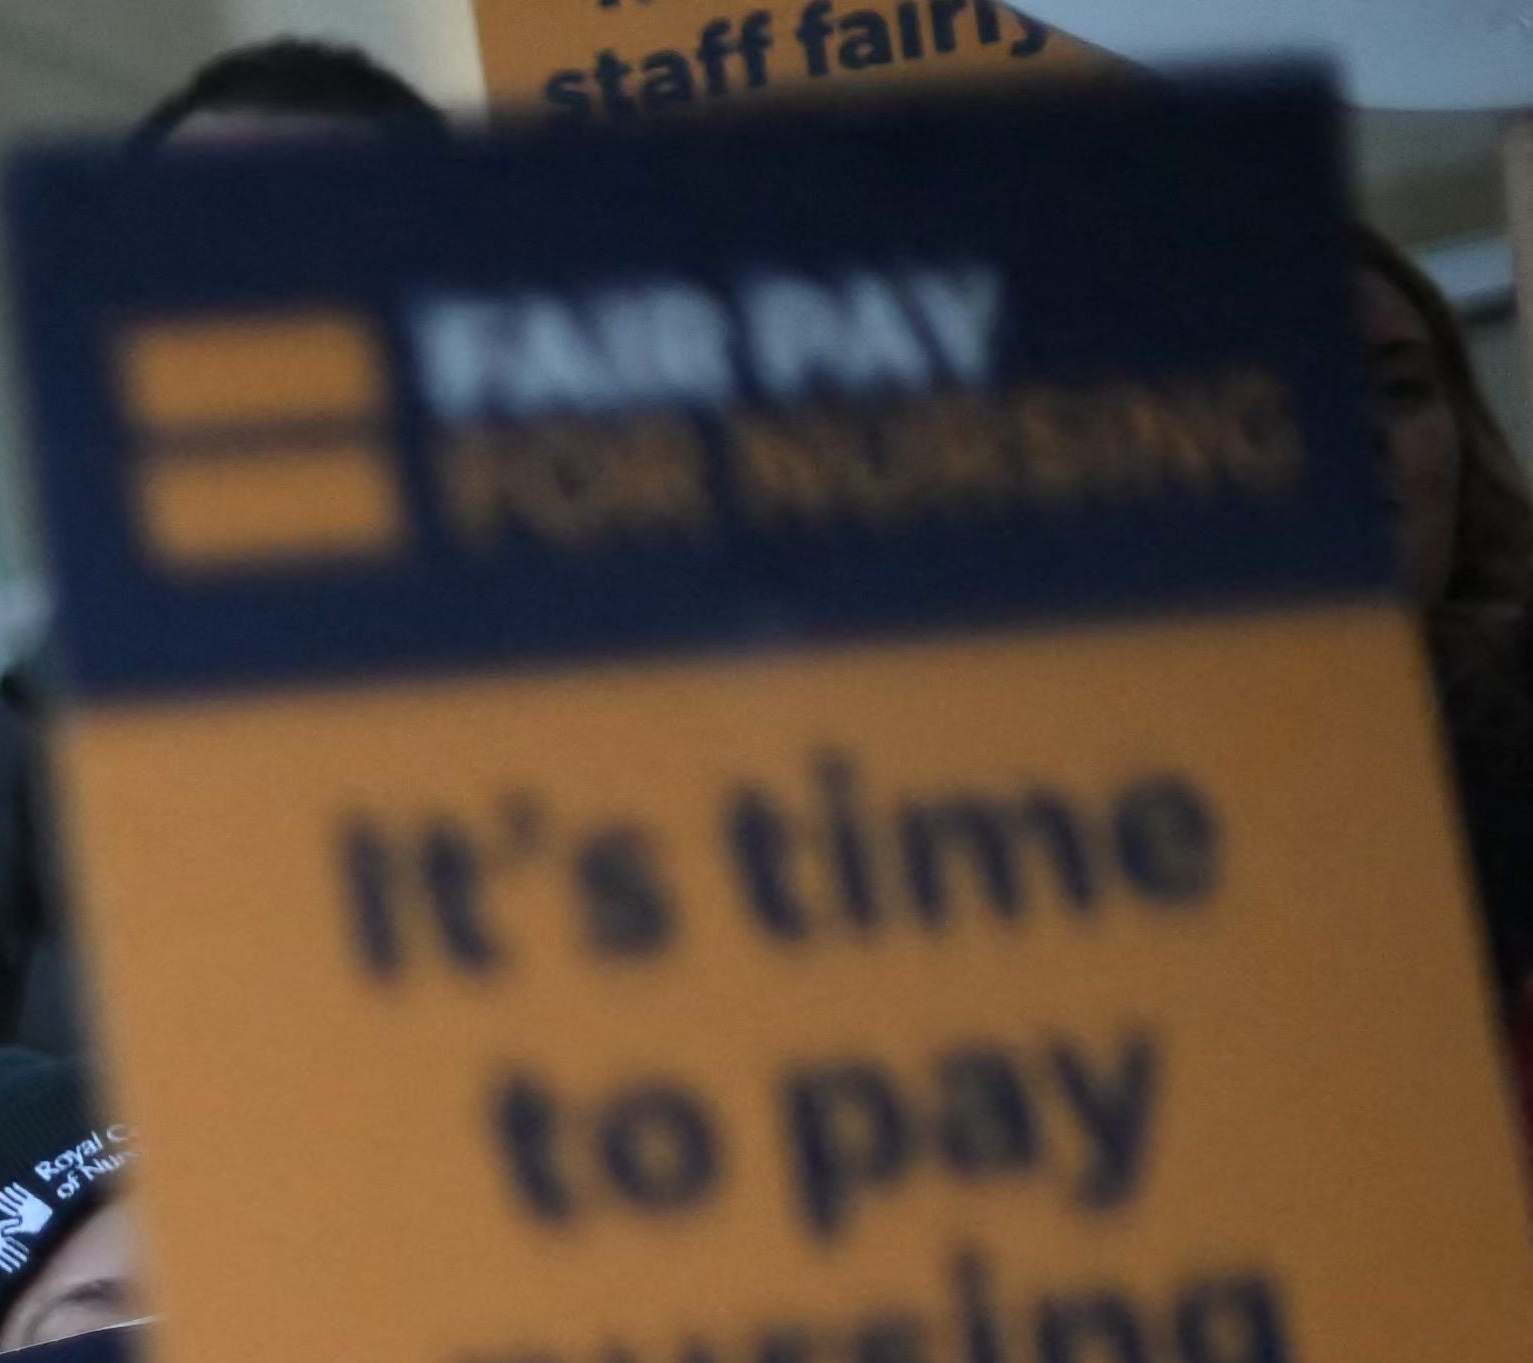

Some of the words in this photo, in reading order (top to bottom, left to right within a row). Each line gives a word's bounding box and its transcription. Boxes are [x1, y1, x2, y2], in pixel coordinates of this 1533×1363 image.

[411, 272, 737, 418] FAIR
[739, 258, 1003, 395] PAY
[725, 745, 1221, 947] time
[34, 1130, 104, 1182] Royal
[57, 1170, 81, 1200] of
[493, 1062, 723, 1240] to
[778, 1020, 1163, 1248] pay
